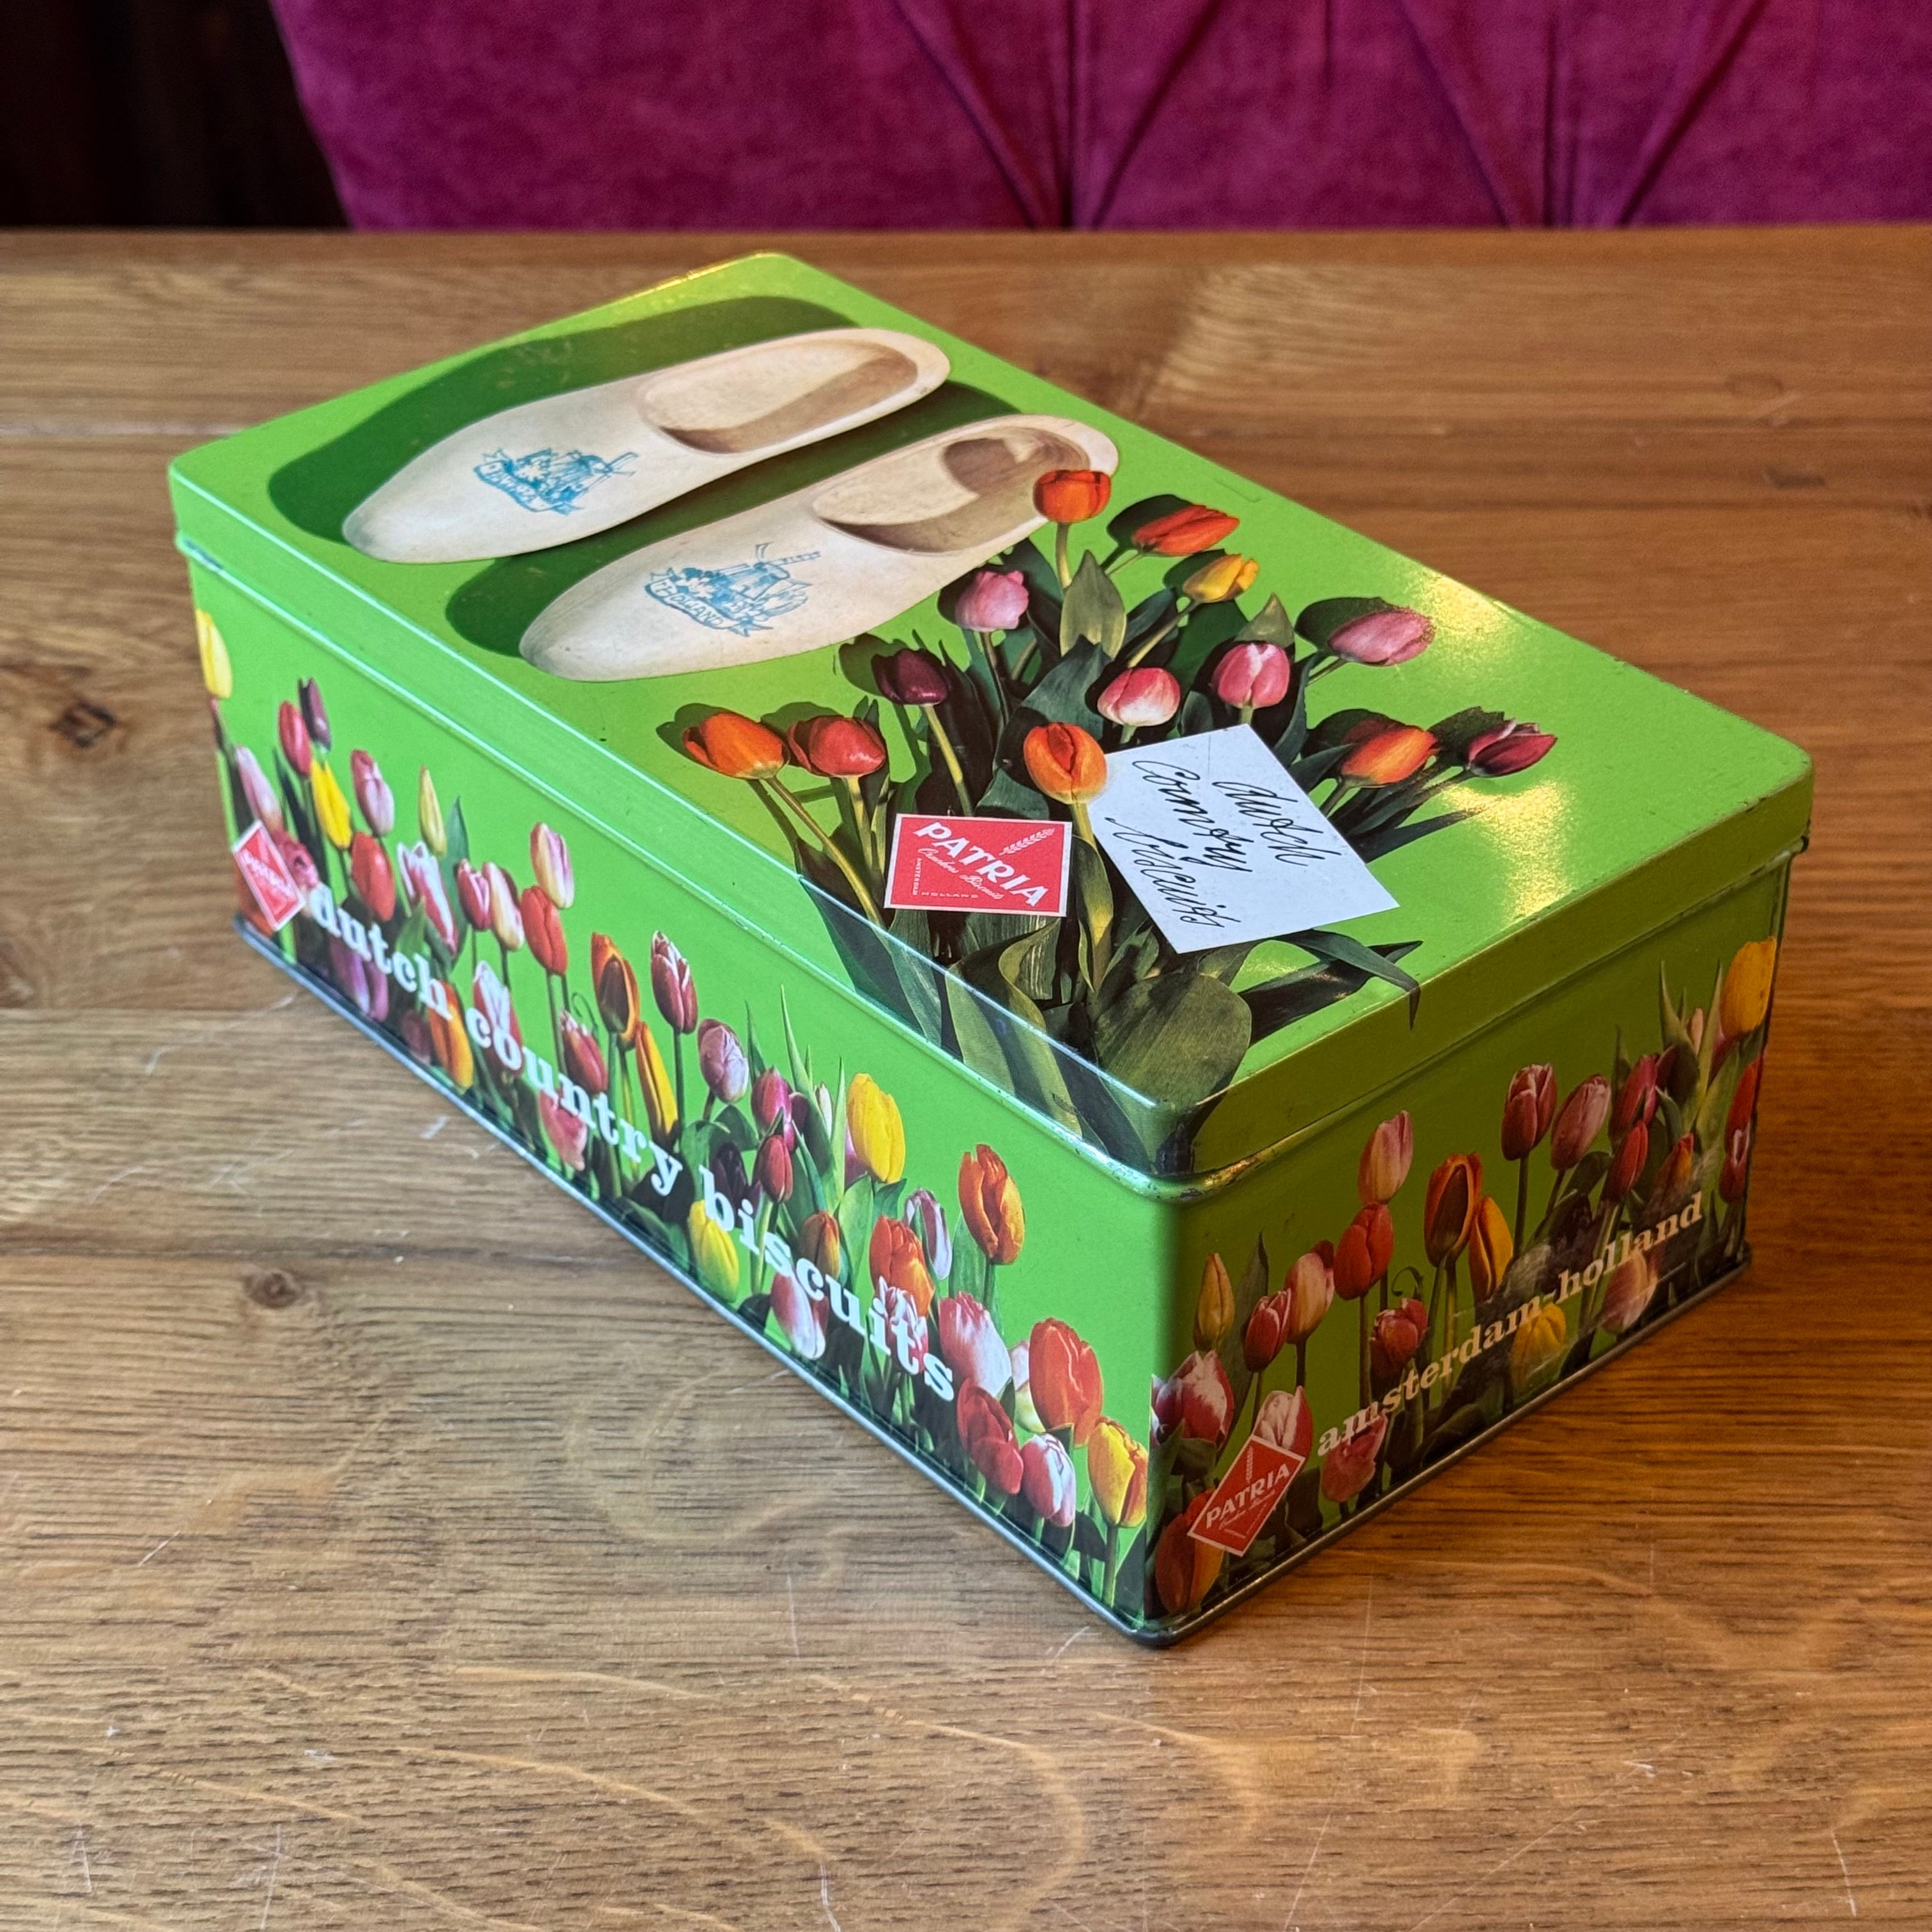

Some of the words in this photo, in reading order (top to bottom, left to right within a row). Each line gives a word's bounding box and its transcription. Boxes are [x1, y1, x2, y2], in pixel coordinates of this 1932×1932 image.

[913, 822, 1050, 907] PATRIA
[307, 880, 454, 1022] dutch
[466, 1007, 683, 1197] country
[698, 1165, 956, 1402] biscuits
[1206, 1462, 1290, 1529] PATRIA
